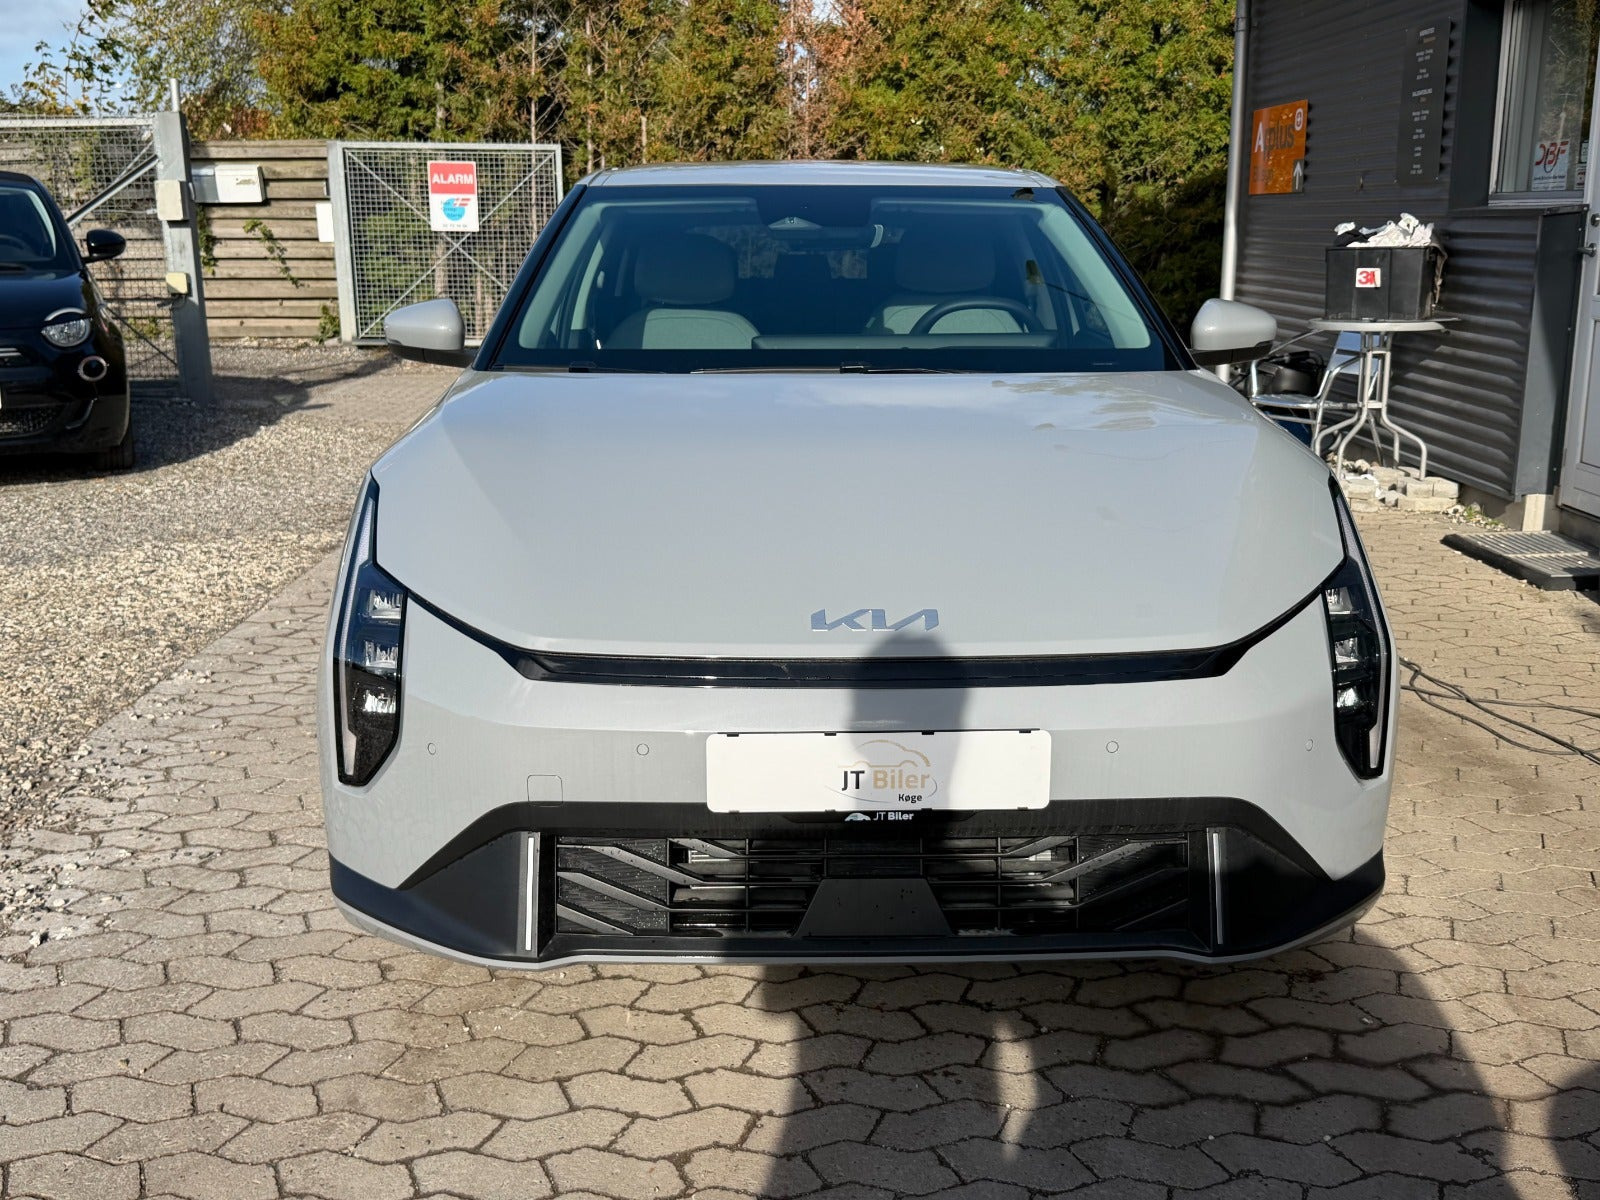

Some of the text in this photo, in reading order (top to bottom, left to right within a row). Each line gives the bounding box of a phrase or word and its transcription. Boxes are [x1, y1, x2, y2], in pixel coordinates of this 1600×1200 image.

[431, 173, 474, 185] ALARM
[810, 608, 939, 632] KIA
[841, 769, 930, 791] JT Biler
[898, 793, 923, 804] Køge
[873, 811, 915, 821] JT Biler
